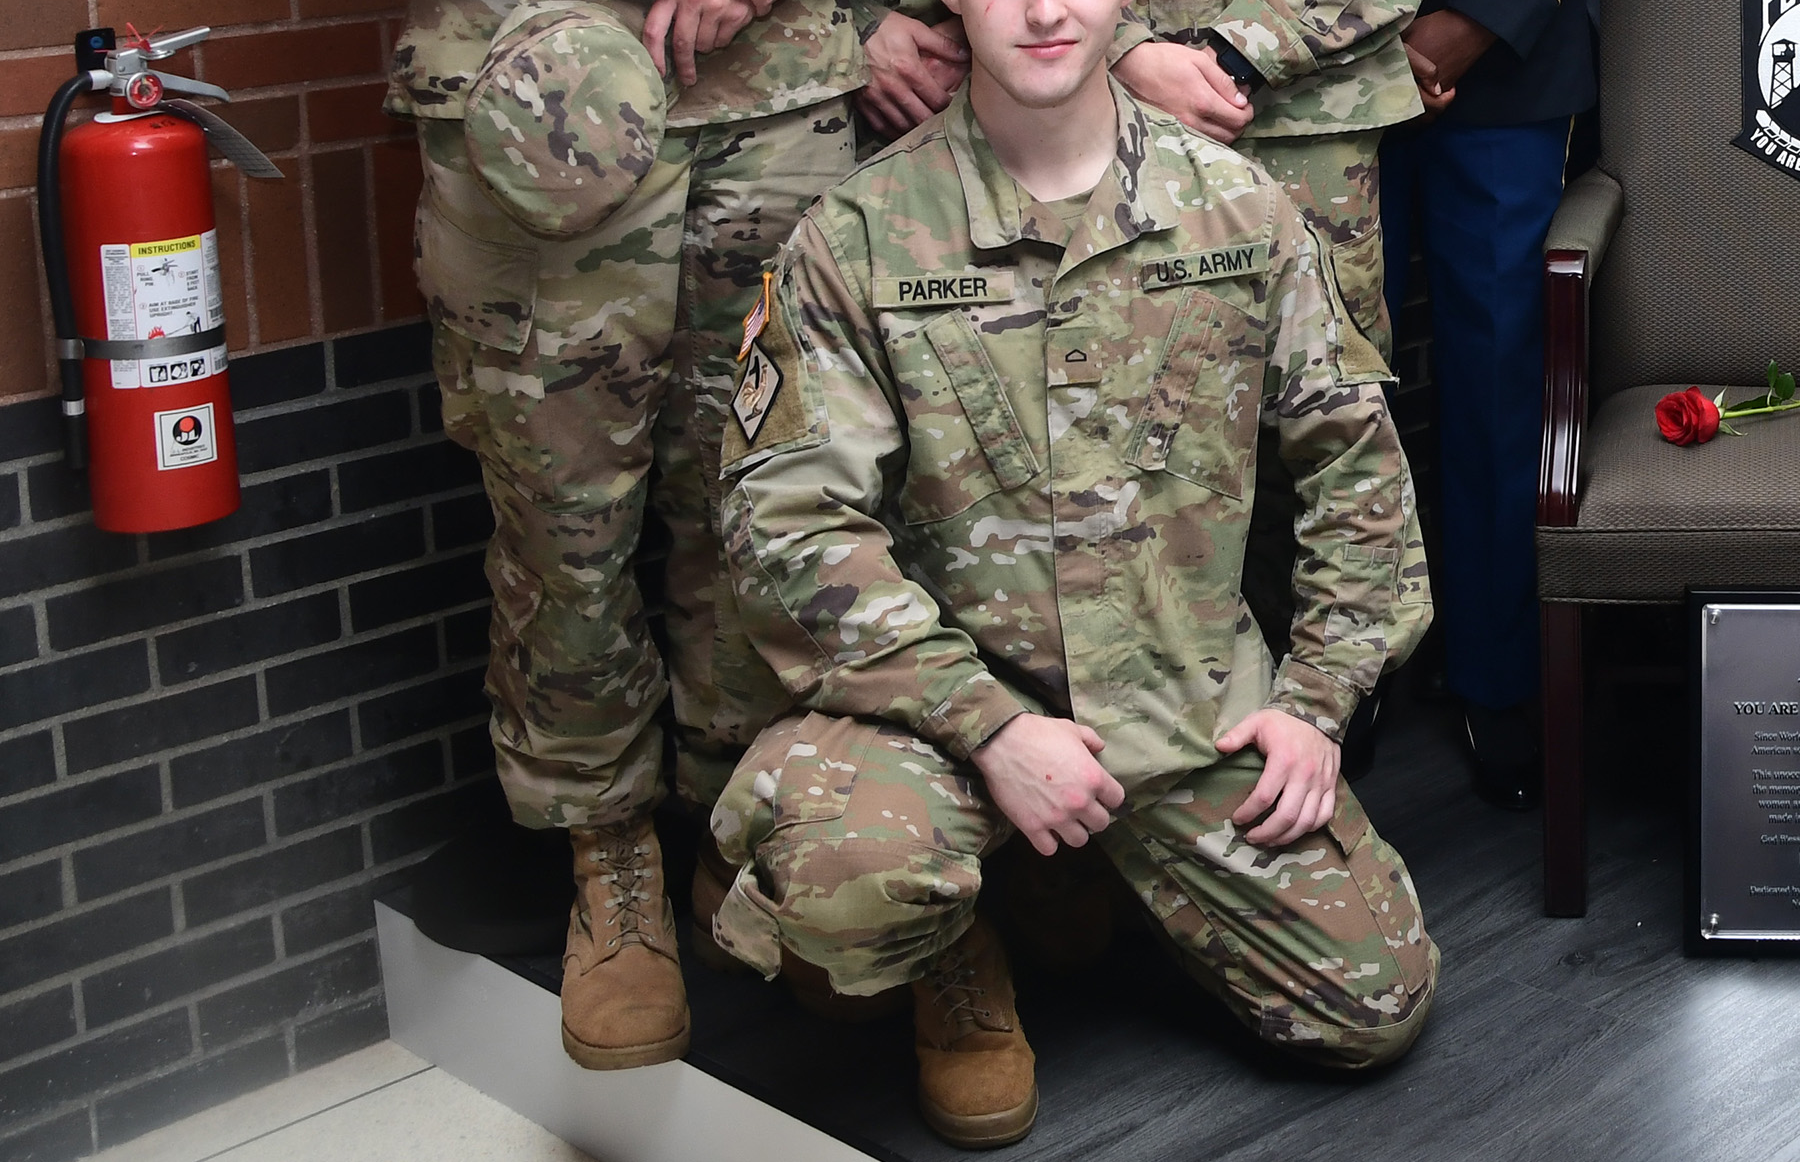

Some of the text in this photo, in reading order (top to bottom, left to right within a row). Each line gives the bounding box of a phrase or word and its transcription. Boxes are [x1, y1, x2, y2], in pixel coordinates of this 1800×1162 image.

[1750, 127, 1773, 156] YOU
[138, 240, 196, 255] INSTRUCTIONS
[1198, 248, 1254, 276] ARMY
[898, 277, 988, 302] PARKER
[1734, 701, 1766, 716] YOU
[1768, 701, 1798, 716] ARE
[1754, 731, 1778, 742] Since
[1751, 745, 1791, 756] American
[1752, 769, 1772, 782] This
[1752, 784, 1768, 796] the
[1758, 798, 1791, 810] women
[1768, 812, 1793, 826] made
